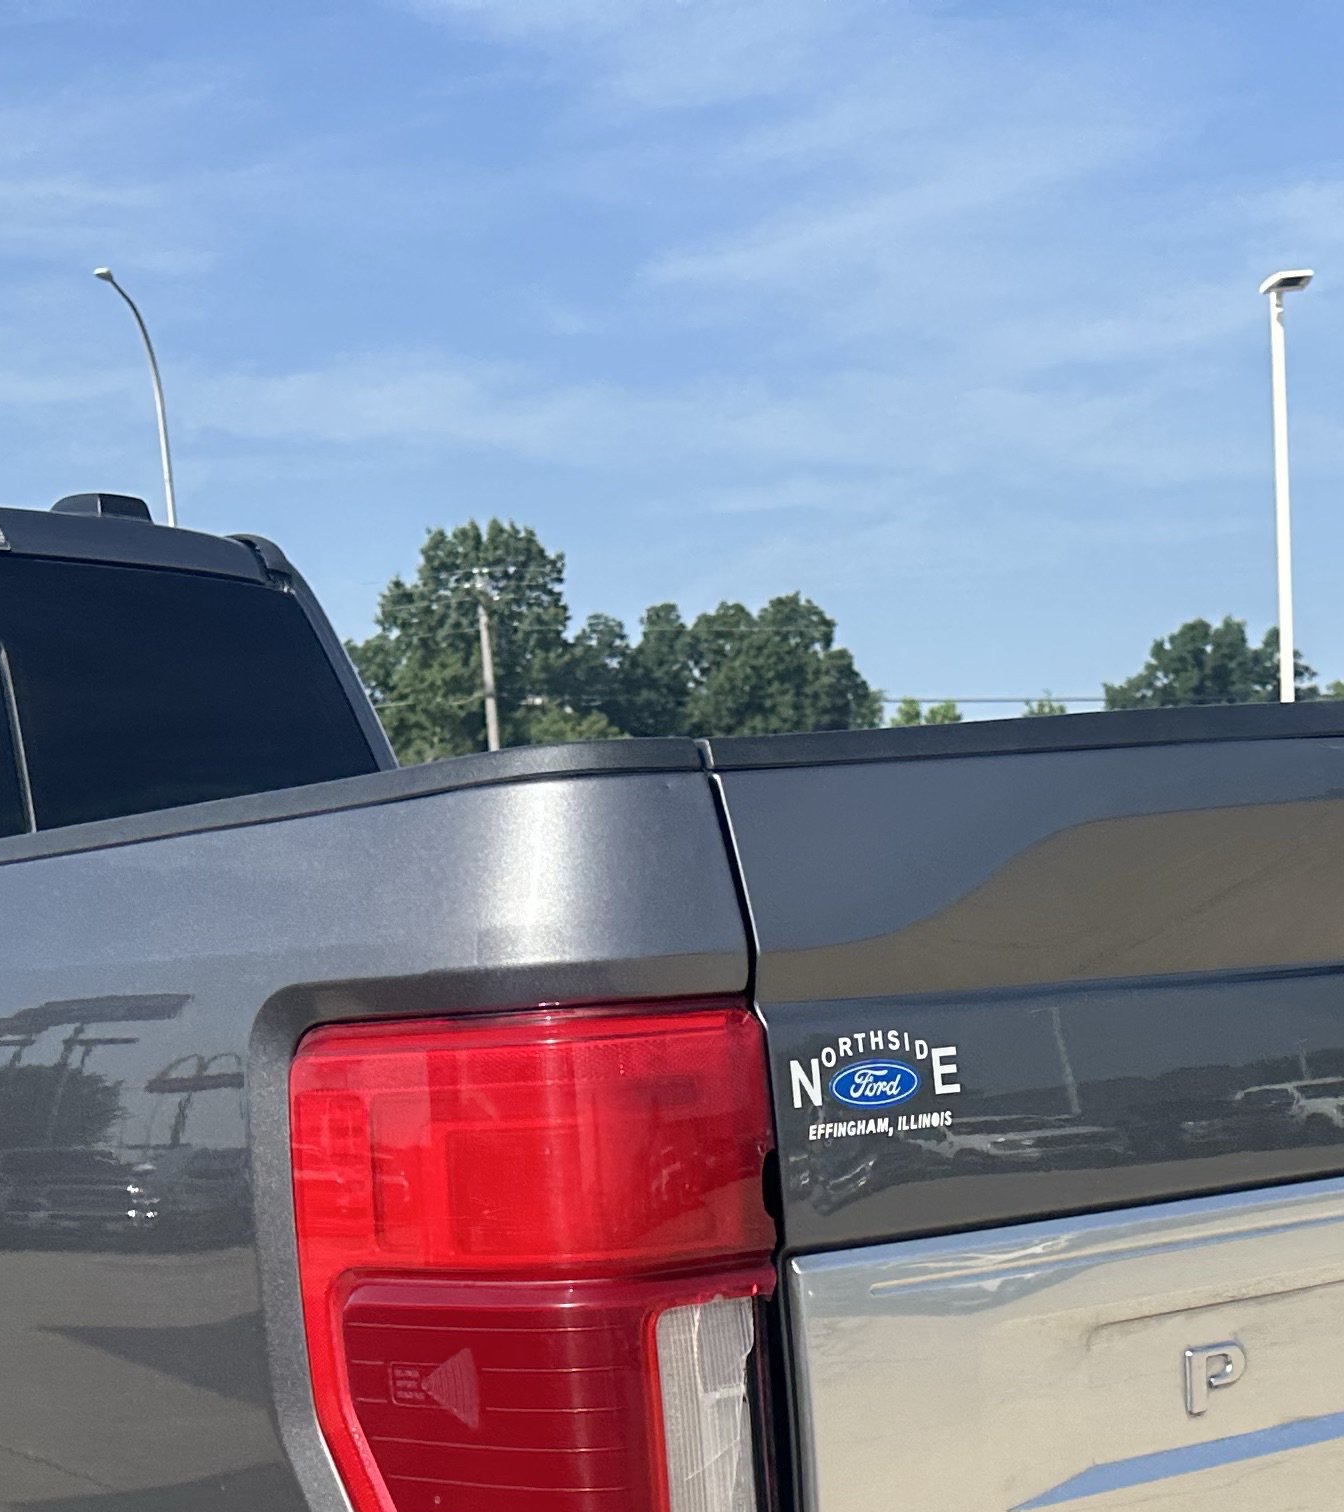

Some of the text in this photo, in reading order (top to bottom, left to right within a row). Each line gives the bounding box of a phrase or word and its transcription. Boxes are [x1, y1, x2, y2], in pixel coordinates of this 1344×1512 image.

[790, 1030, 961, 1109] NORTHSIDE
[849, 1069, 901, 1098] Ford
[809, 1111, 953, 1141] EFFINGHAM, ILLINOIS
